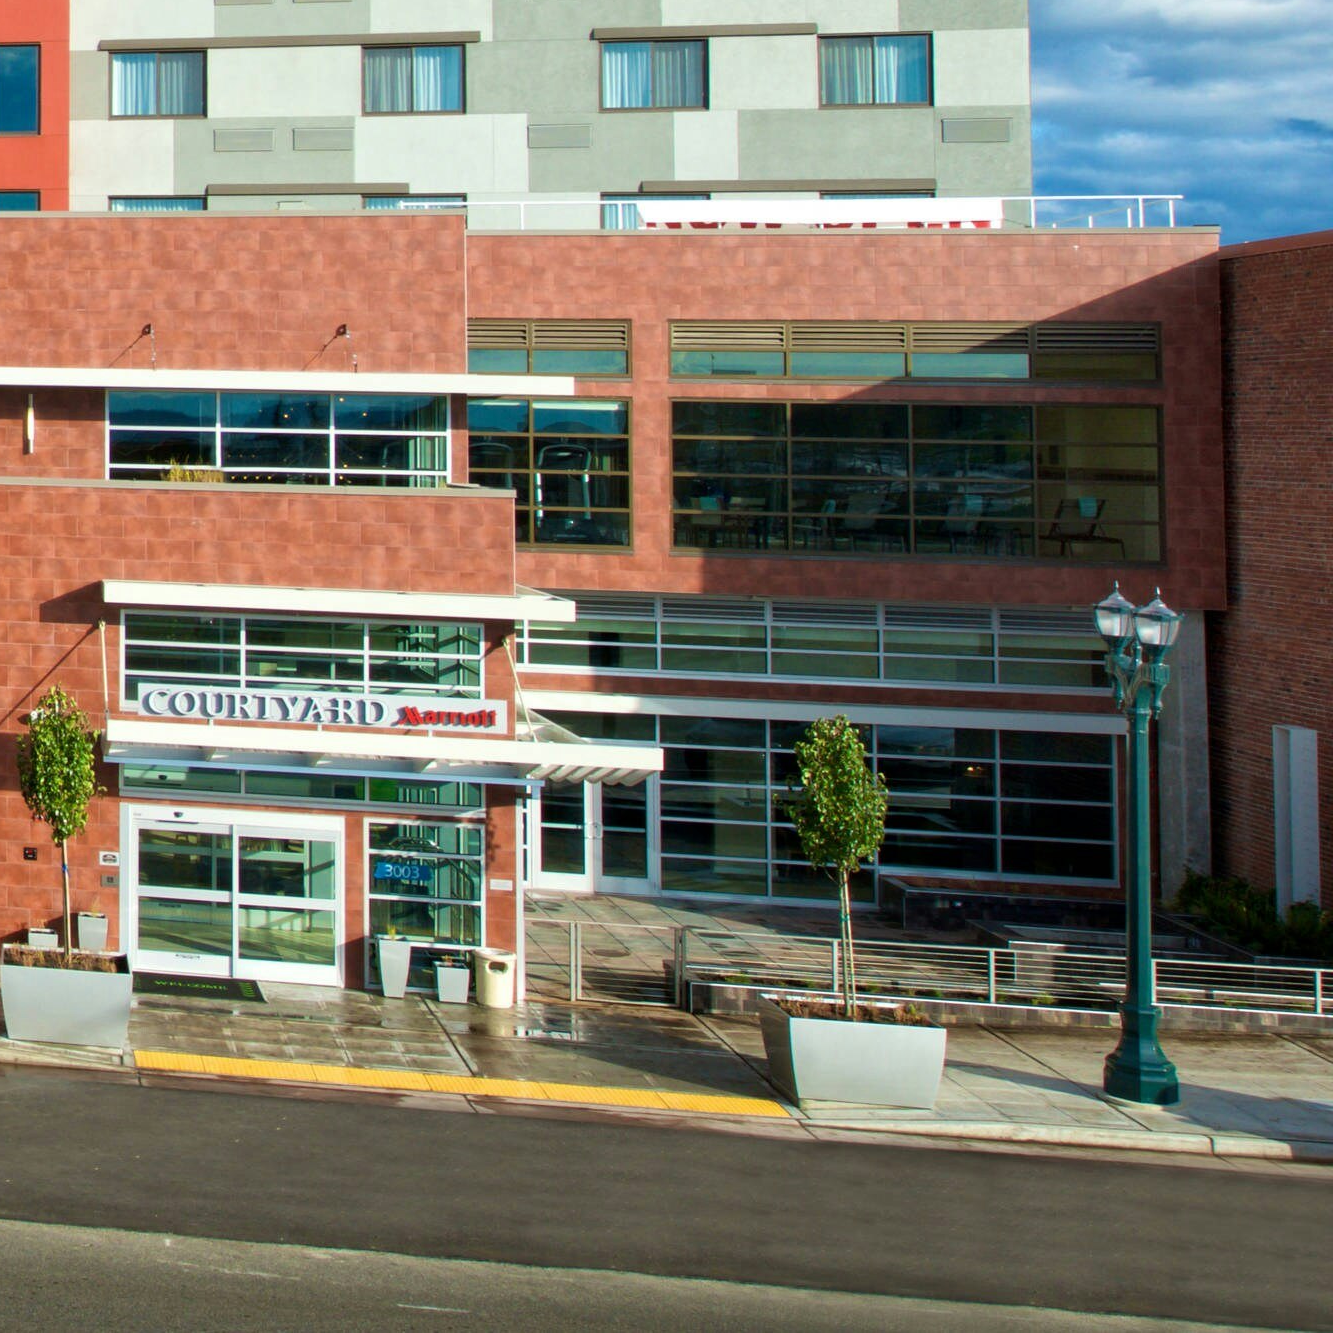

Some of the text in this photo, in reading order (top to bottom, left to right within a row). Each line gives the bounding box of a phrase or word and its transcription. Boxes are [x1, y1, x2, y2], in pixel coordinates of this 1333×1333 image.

[145, 688, 497, 727] COURTYARD Marriott
[384, 864, 420, 879] 3003
